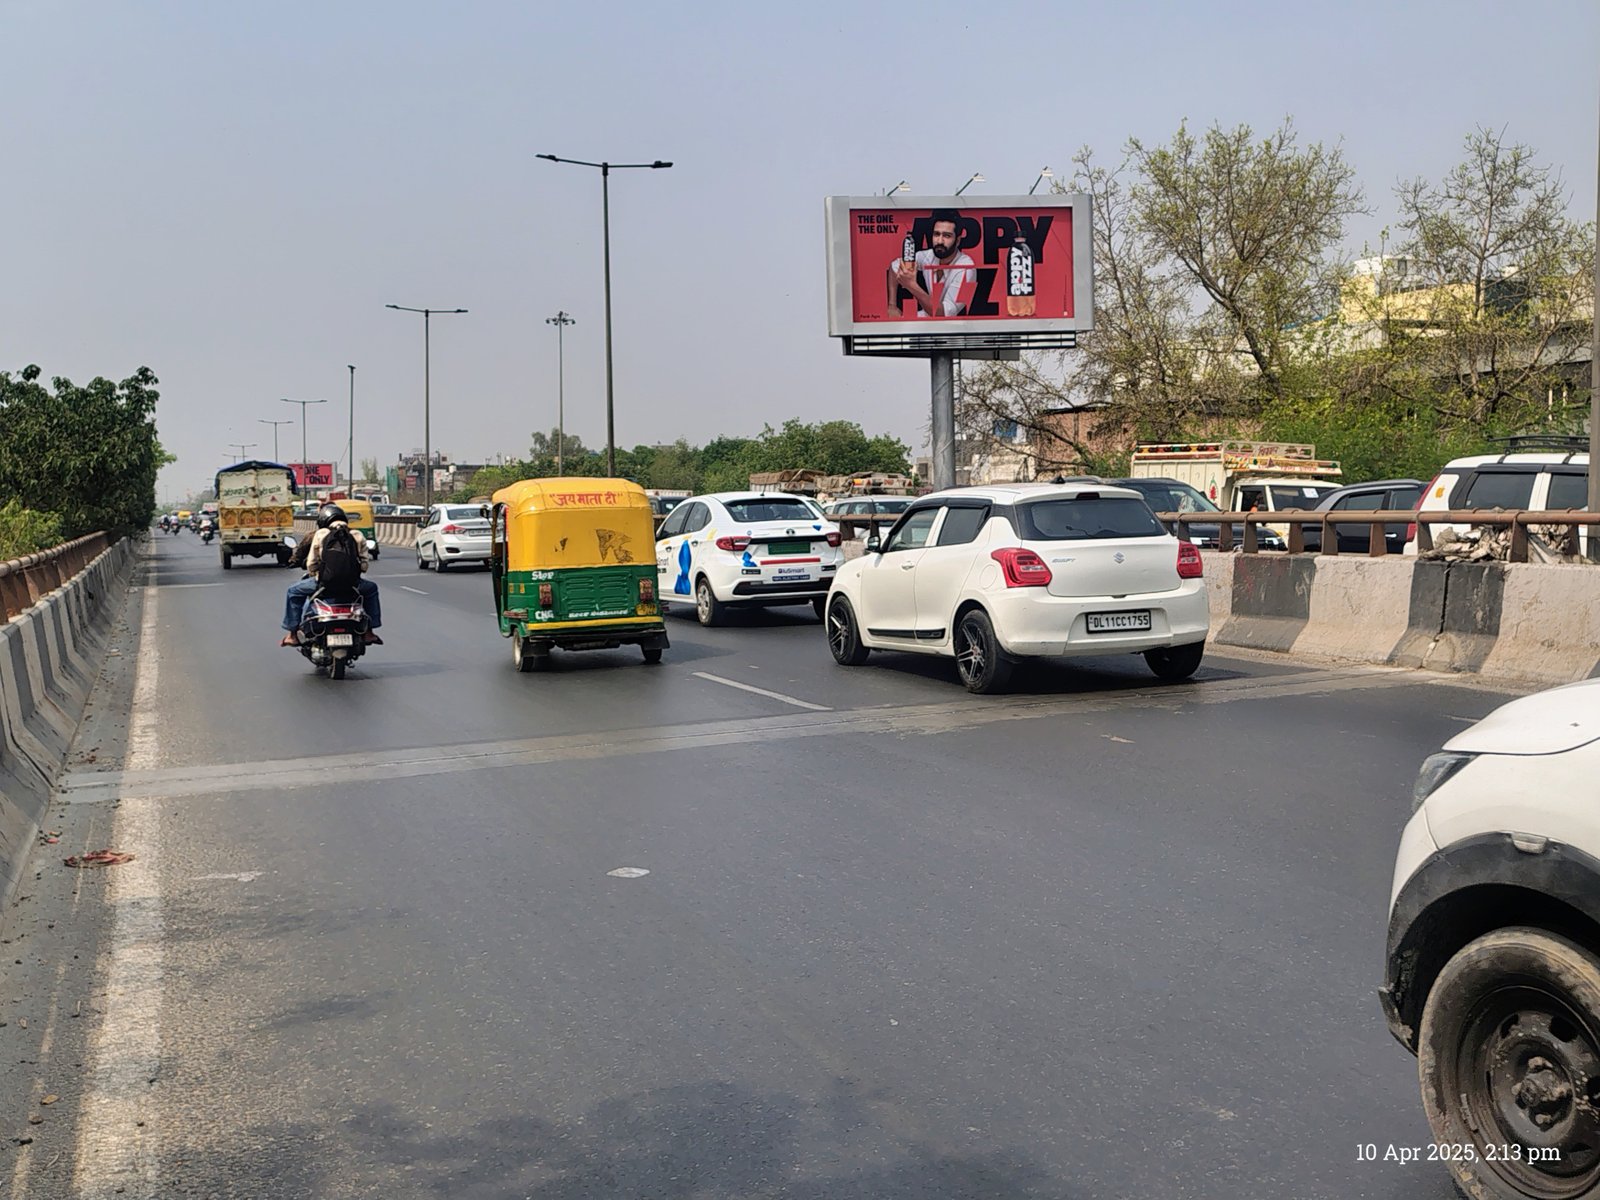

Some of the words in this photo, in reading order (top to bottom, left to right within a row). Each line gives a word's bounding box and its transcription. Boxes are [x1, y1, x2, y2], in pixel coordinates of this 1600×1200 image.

[858, 215, 875, 224] THE
[876, 215, 894, 224] ONE
[858, 225, 875, 234] THE
[876, 225, 899, 234] ONLY
[309, 475, 330, 485] ONLY
[576, 493, 603, 506] माता
[534, 610, 554, 621] CNG
[1093, 614, 1150, 629] DL11CC1755
